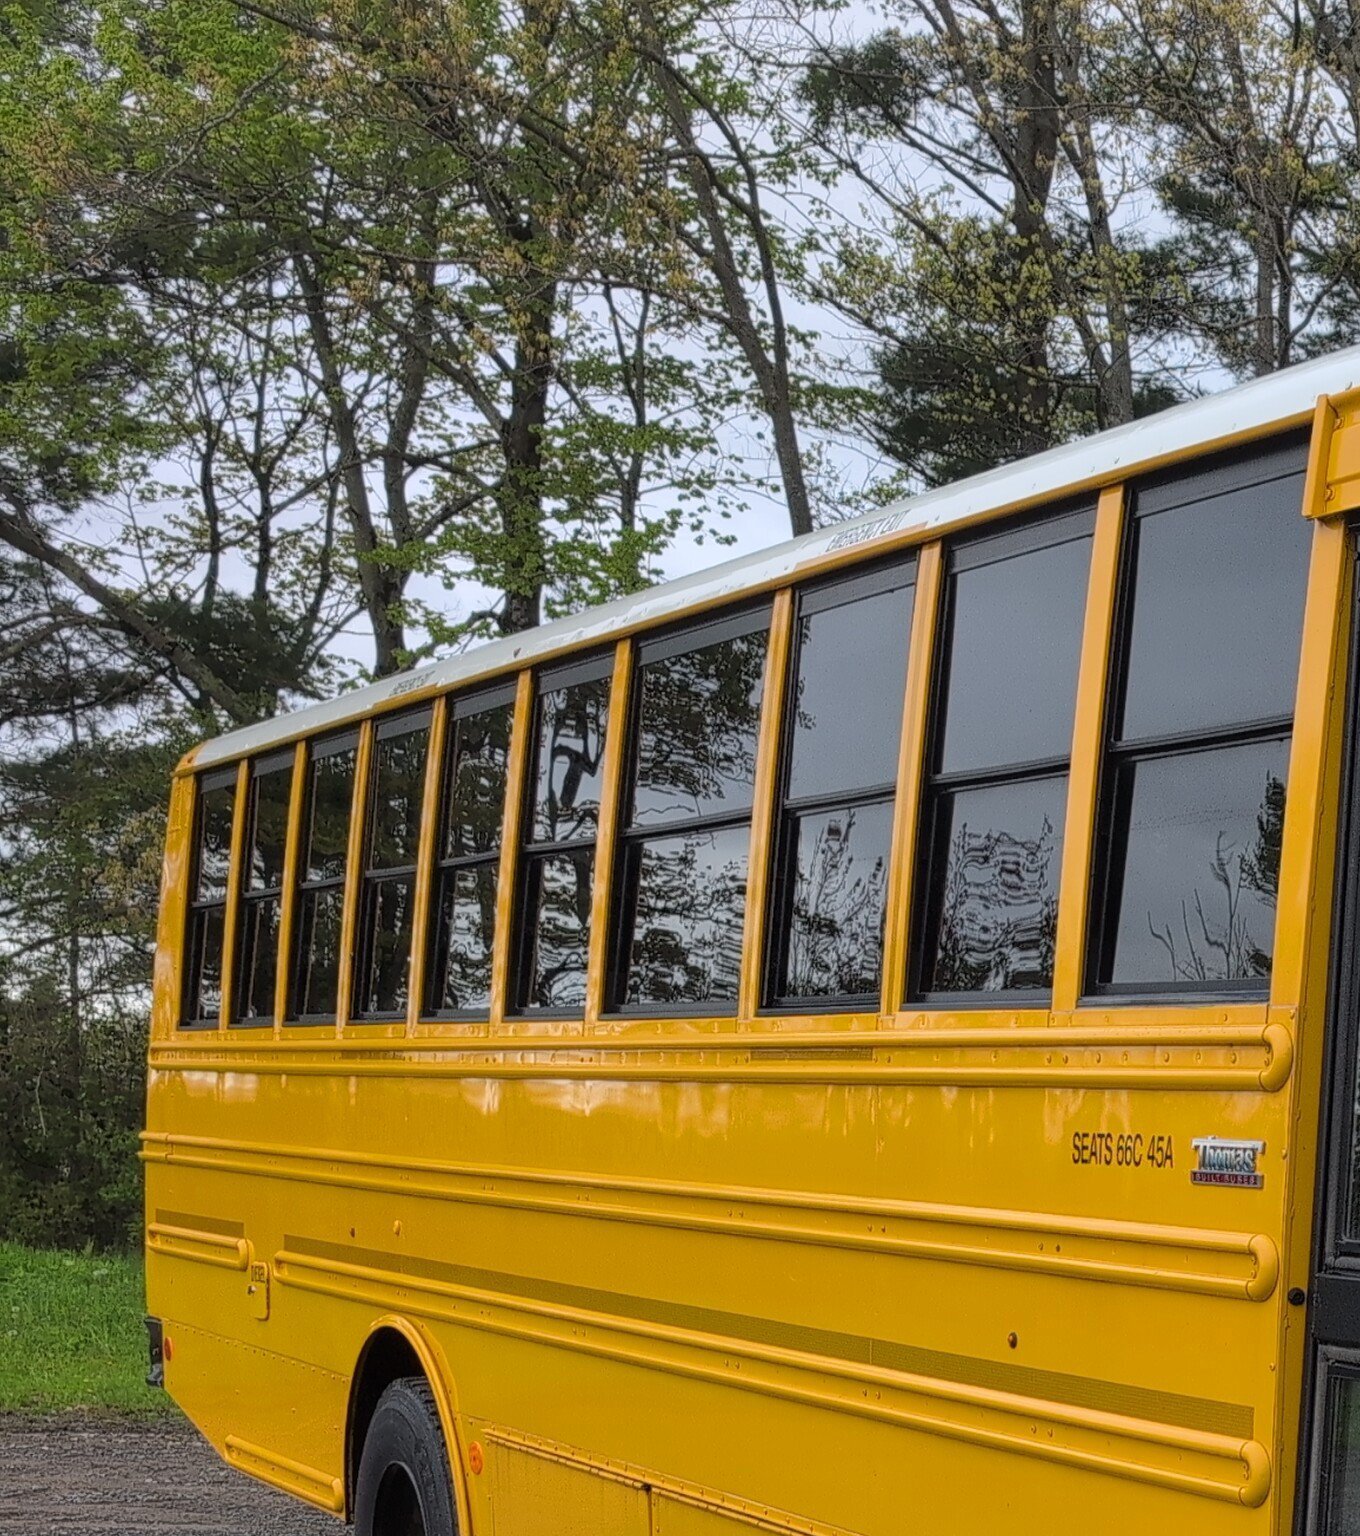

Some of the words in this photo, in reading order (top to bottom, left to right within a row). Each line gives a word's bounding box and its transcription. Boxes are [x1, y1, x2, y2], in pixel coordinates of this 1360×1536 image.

[1072, 1131, 1113, 1166] SEATS
[1116, 1133, 1143, 1167] 66C
[1146, 1135, 1174, 1169] 45A
[1191, 1135, 1266, 1173] Thomas
